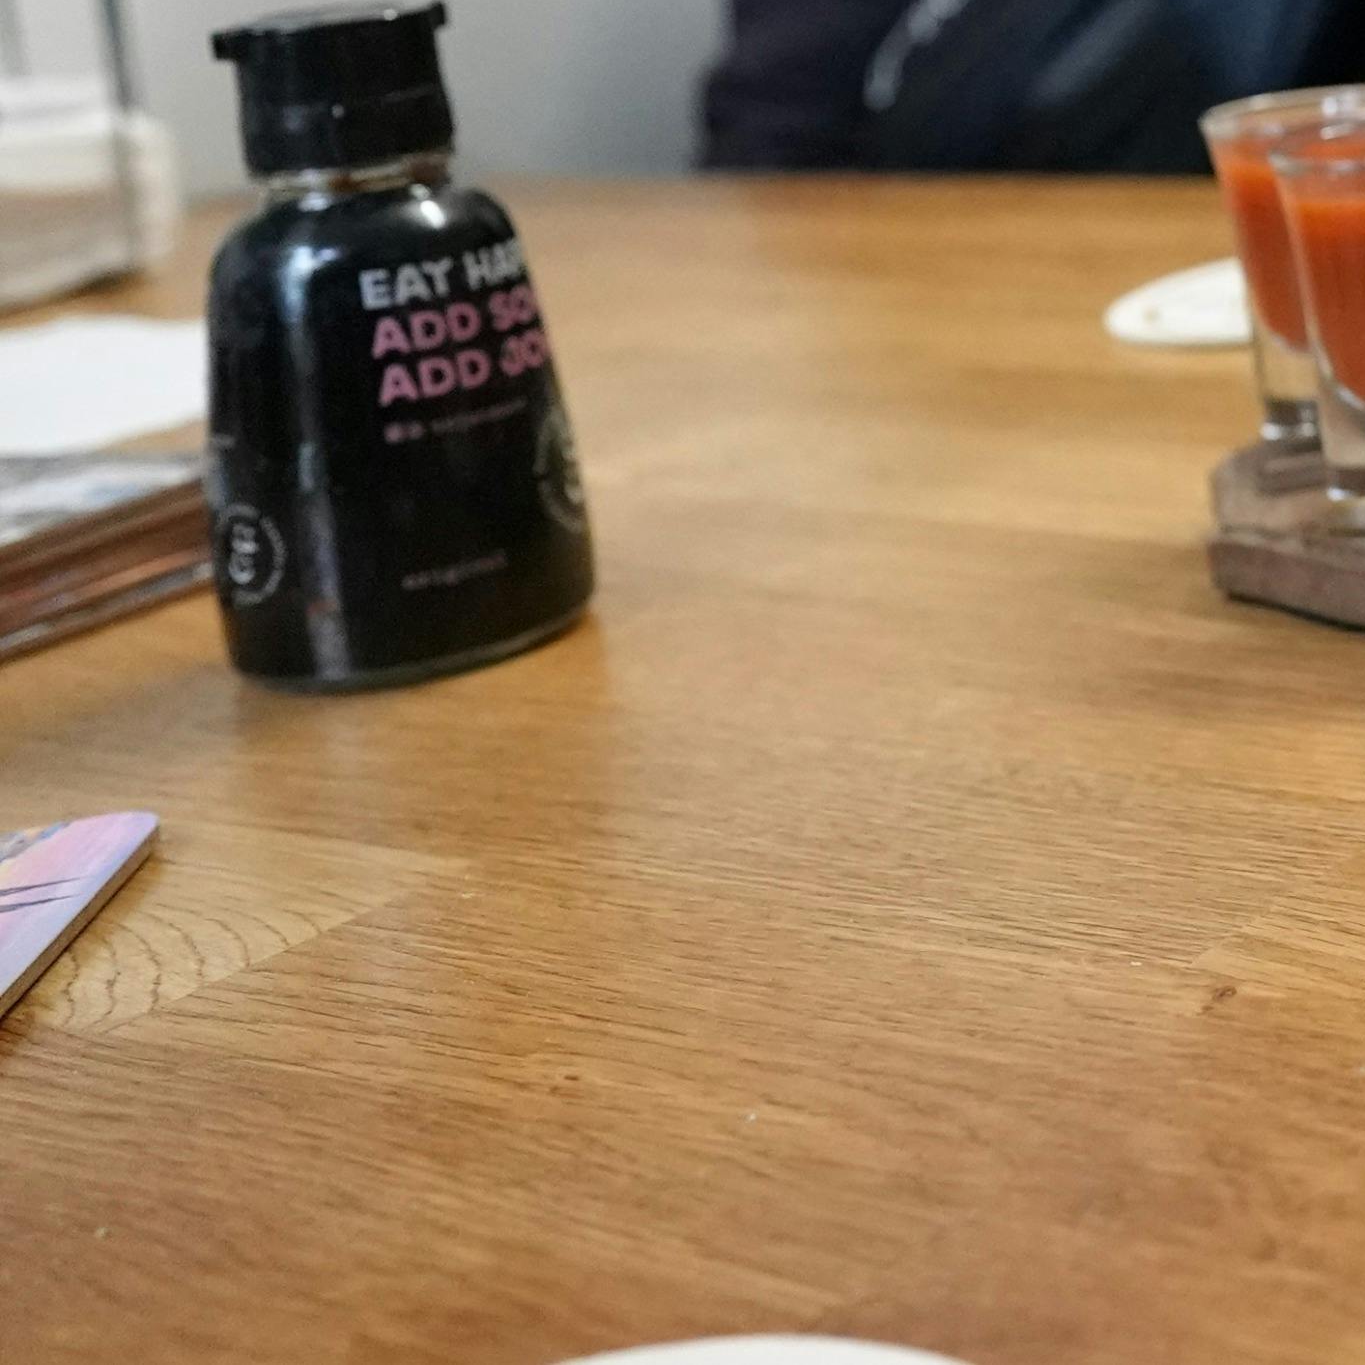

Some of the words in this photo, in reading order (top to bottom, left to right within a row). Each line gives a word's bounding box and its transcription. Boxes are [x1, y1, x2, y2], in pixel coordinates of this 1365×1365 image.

[359, 258, 453, 312] EAT
[371, 301, 482, 361] ADD
[378, 348, 492, 407] ADD
